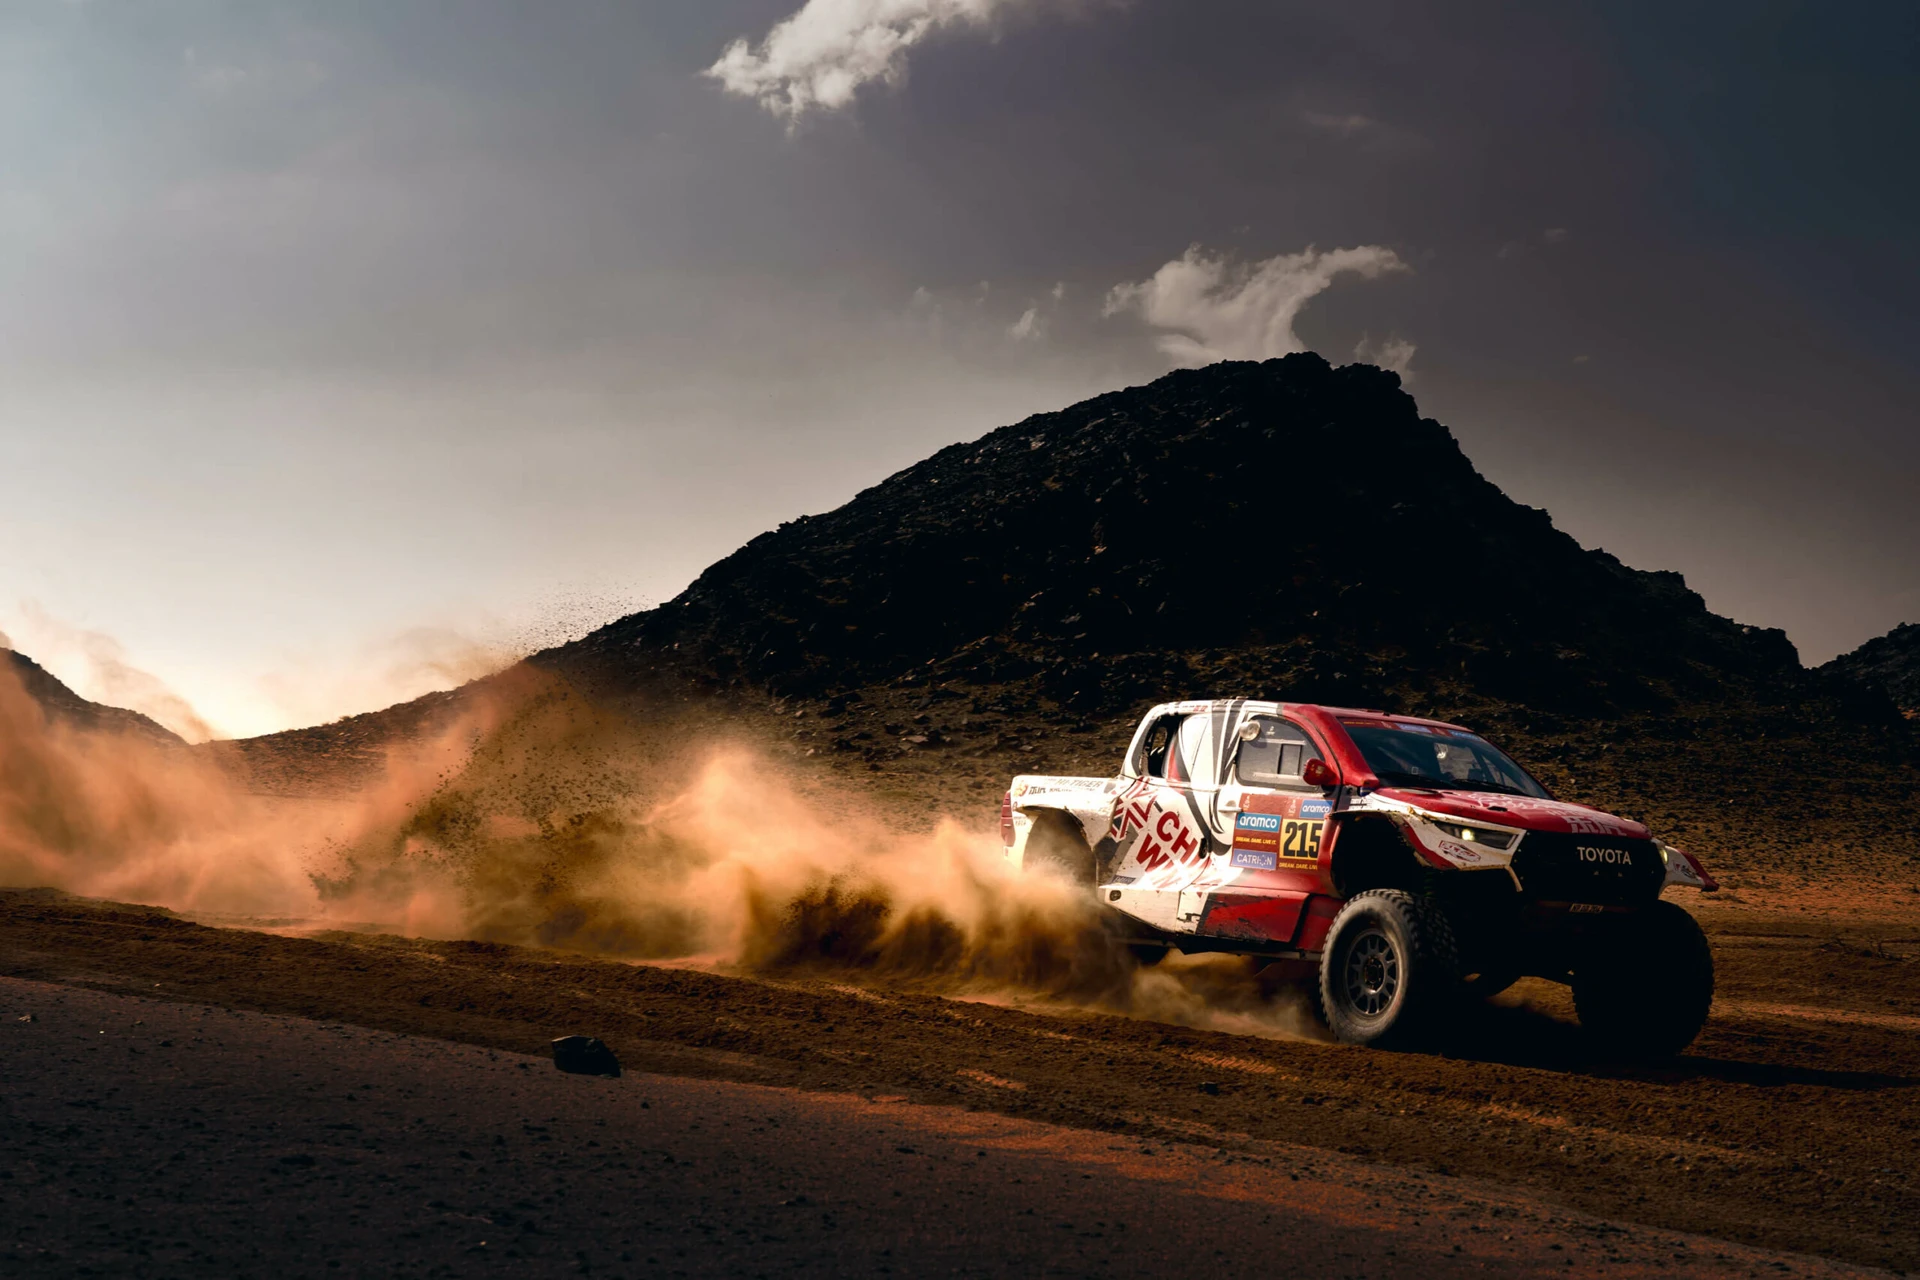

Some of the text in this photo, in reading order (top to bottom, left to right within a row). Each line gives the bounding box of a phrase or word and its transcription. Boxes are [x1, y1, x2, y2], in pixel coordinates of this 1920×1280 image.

[1302, 804, 1330, 813] aramco
[1239, 815, 1278, 829] aramco
[1283, 821, 1323, 858] 215
[1576, 846, 1632, 865] TOYOTA
